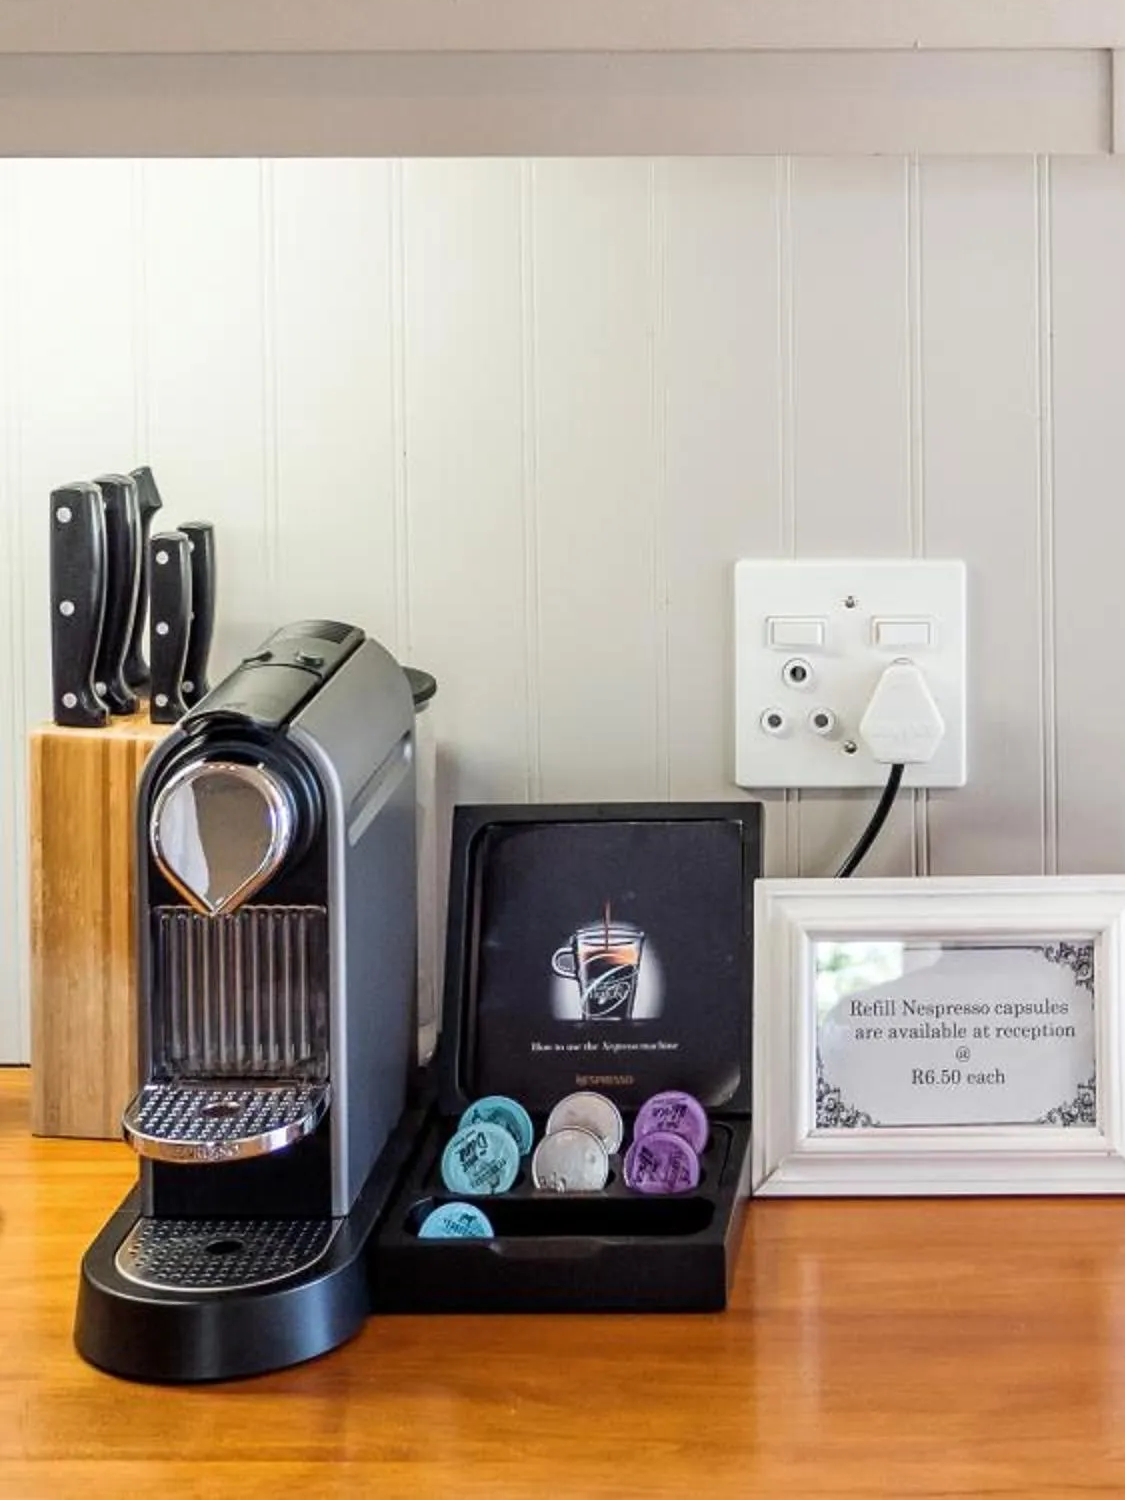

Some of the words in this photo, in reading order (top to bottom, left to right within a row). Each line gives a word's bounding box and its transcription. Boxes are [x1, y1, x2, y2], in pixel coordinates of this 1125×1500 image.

[850, 999, 896, 1017] Refill
[902, 999, 991, 1019] Nespresso
[994, 998, 1070, 1018] capsules
[854, 1027, 884, 1040] are
[887, 1022, 967, 1040] available
[972, 1025, 991, 1039] at
[994, 1022, 1076, 1041] reception
[954, 1045, 972, 1063] @
[911, 1068, 961, 1086] R6.50
[966, 1067, 1006, 1085] each
